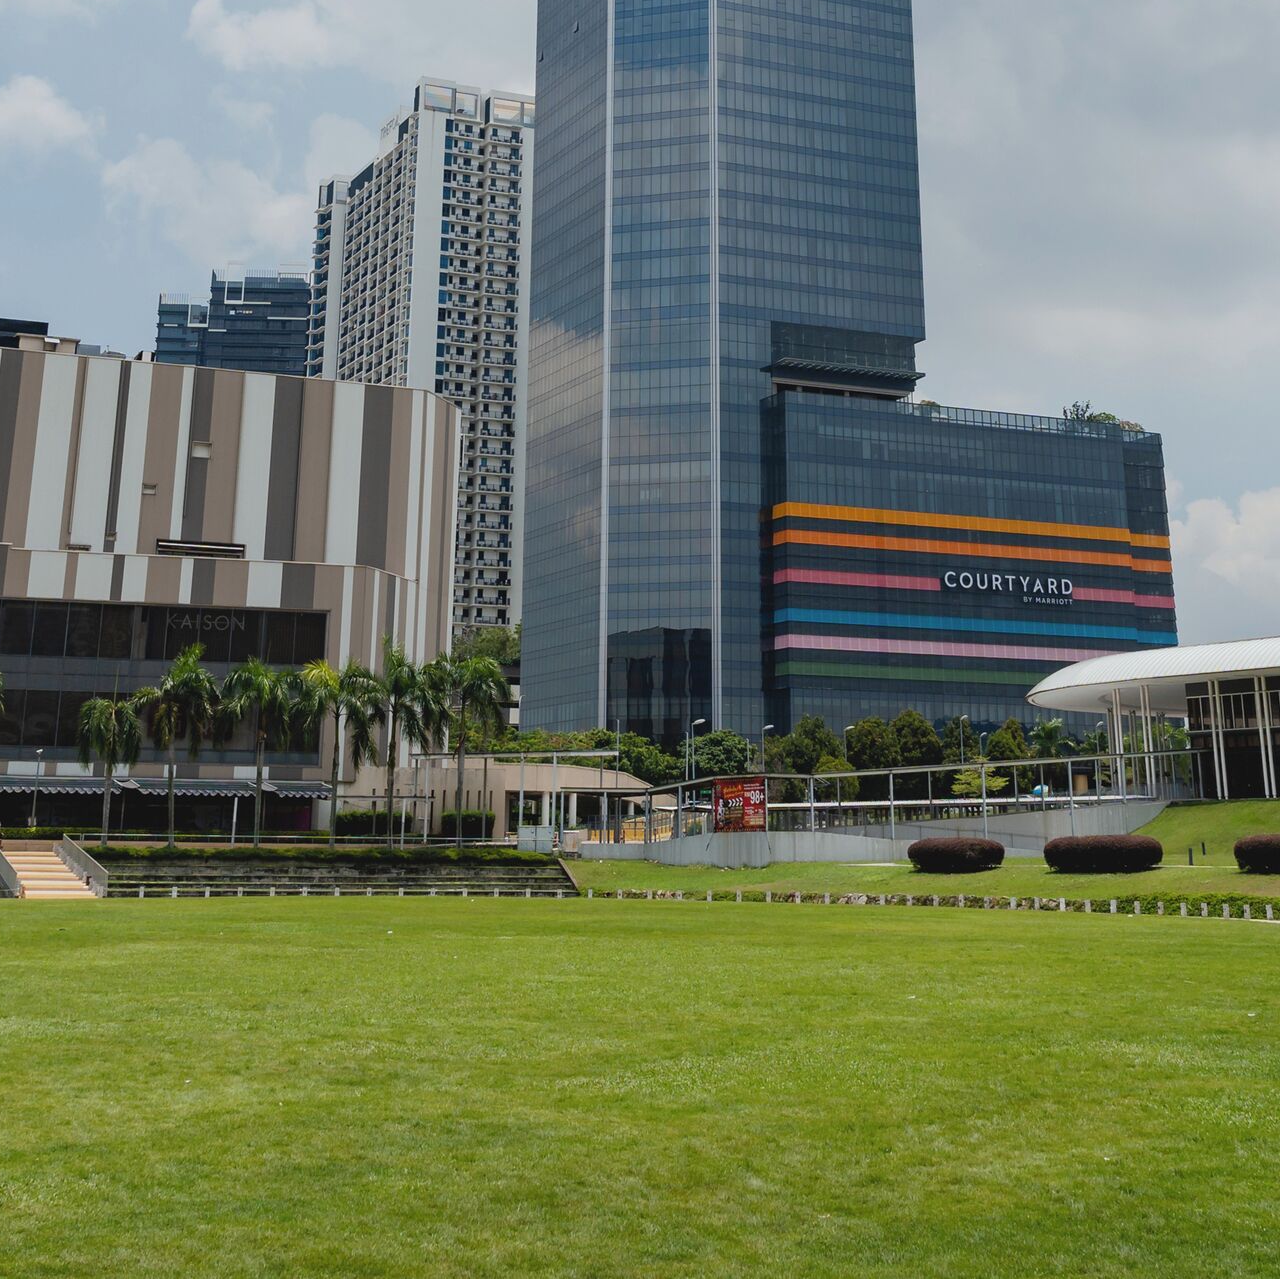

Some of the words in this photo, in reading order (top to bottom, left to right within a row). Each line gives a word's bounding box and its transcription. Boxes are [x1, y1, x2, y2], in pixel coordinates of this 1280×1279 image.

[944, 571, 1073, 595] COURTYARD
[1035, 597, 1073, 605] MARRIOTT
[167, 613, 245, 631] KAISON
